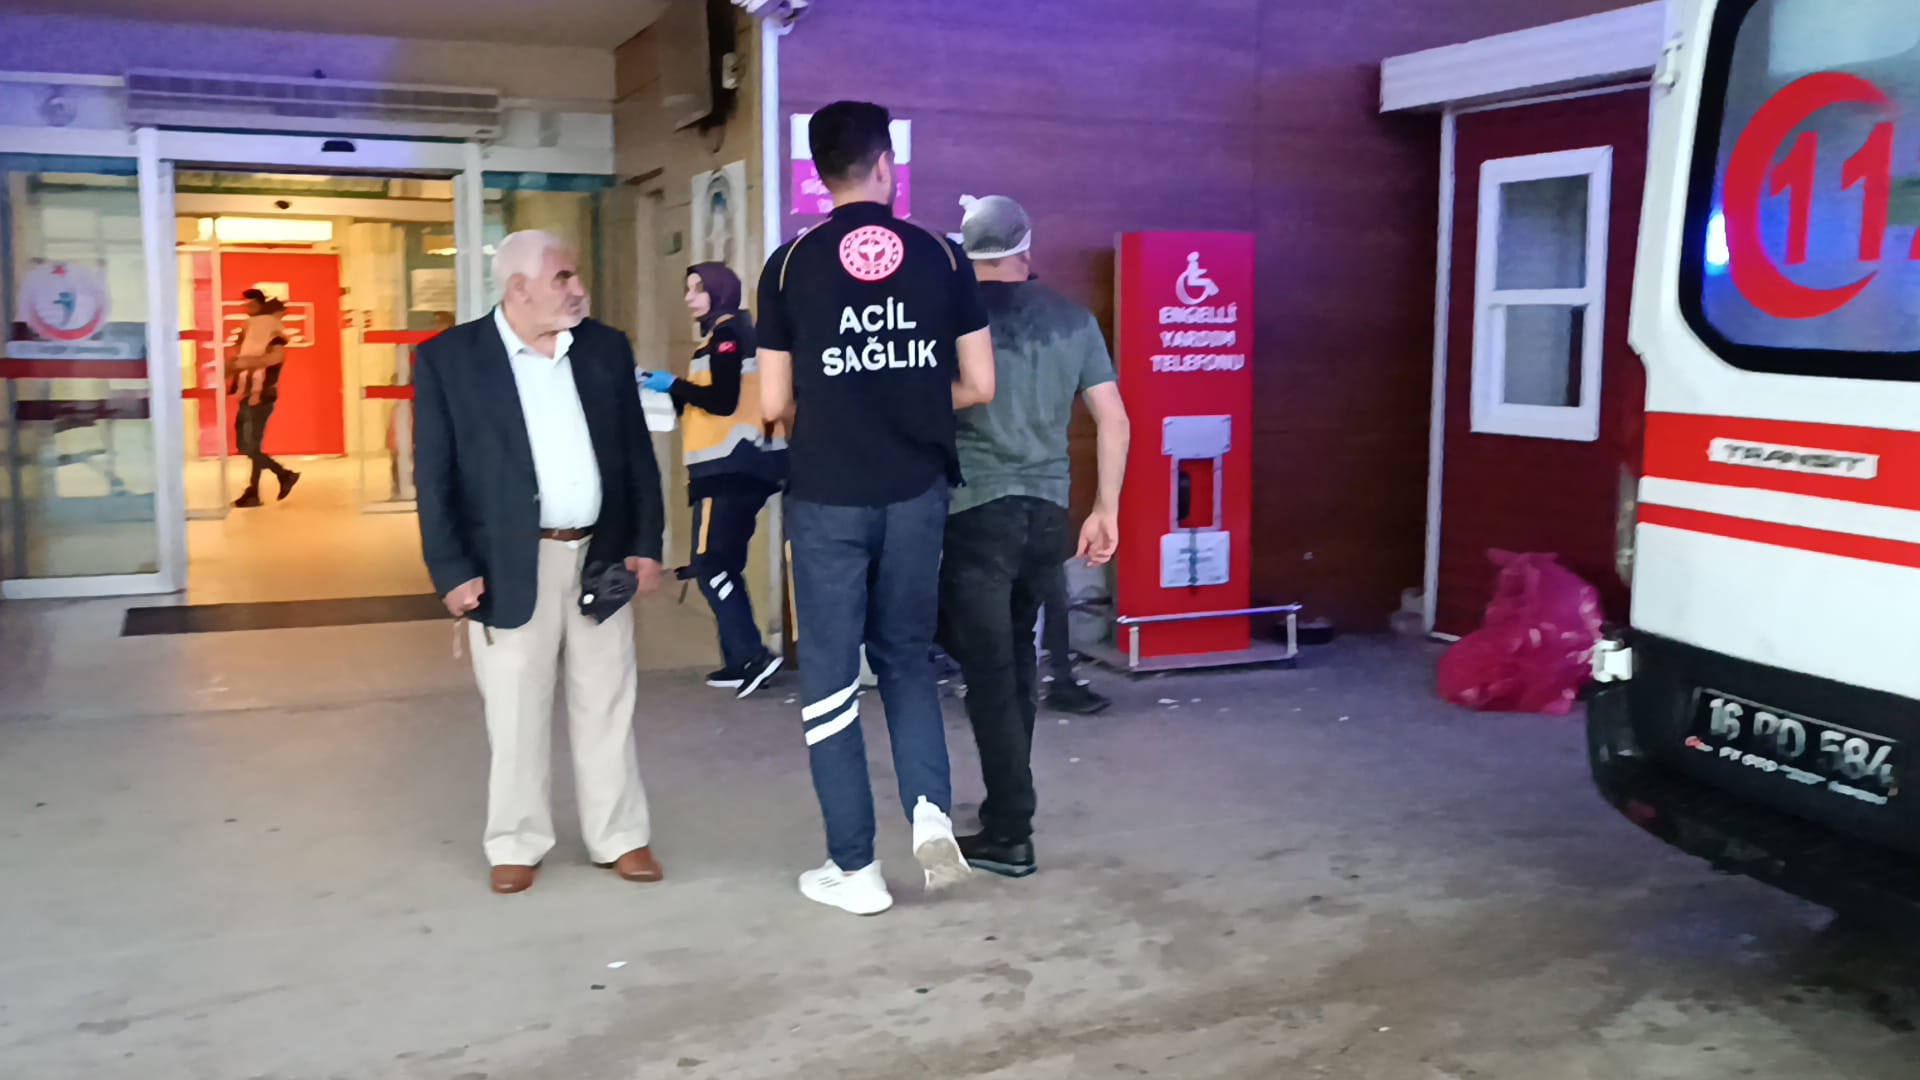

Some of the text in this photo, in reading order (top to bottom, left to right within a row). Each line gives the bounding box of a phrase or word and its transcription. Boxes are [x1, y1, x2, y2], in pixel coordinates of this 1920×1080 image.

[1770, 121, 1920, 265] 11
[840, 296, 917, 335] ACİL
[821, 336, 937, 377] SAĞLIK
[1709, 698, 1743, 740] 16
